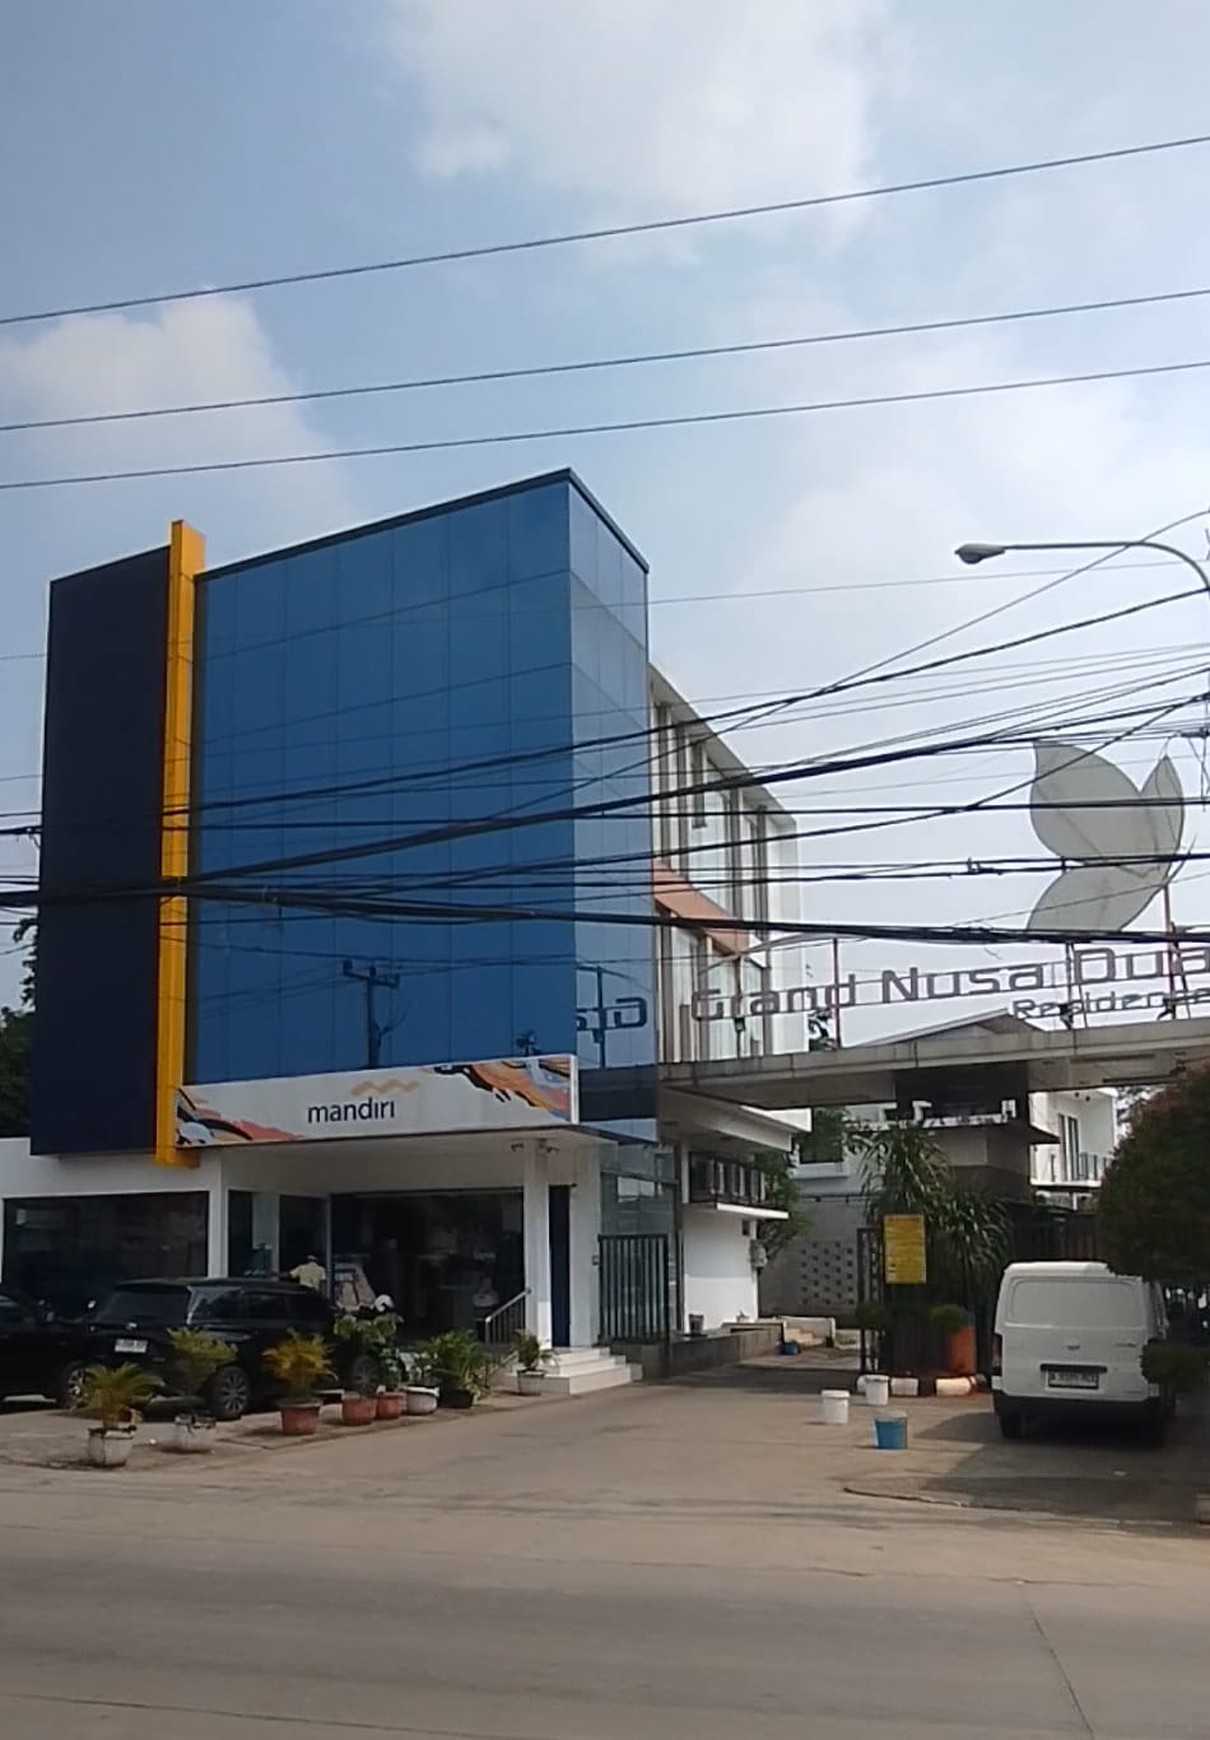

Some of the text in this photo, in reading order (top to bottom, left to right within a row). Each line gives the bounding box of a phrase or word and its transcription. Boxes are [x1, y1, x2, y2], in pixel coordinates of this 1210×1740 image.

[692, 945, 1210, 1021] Grand Nusa Dua
[307, 1096, 395, 1123] mandiri
